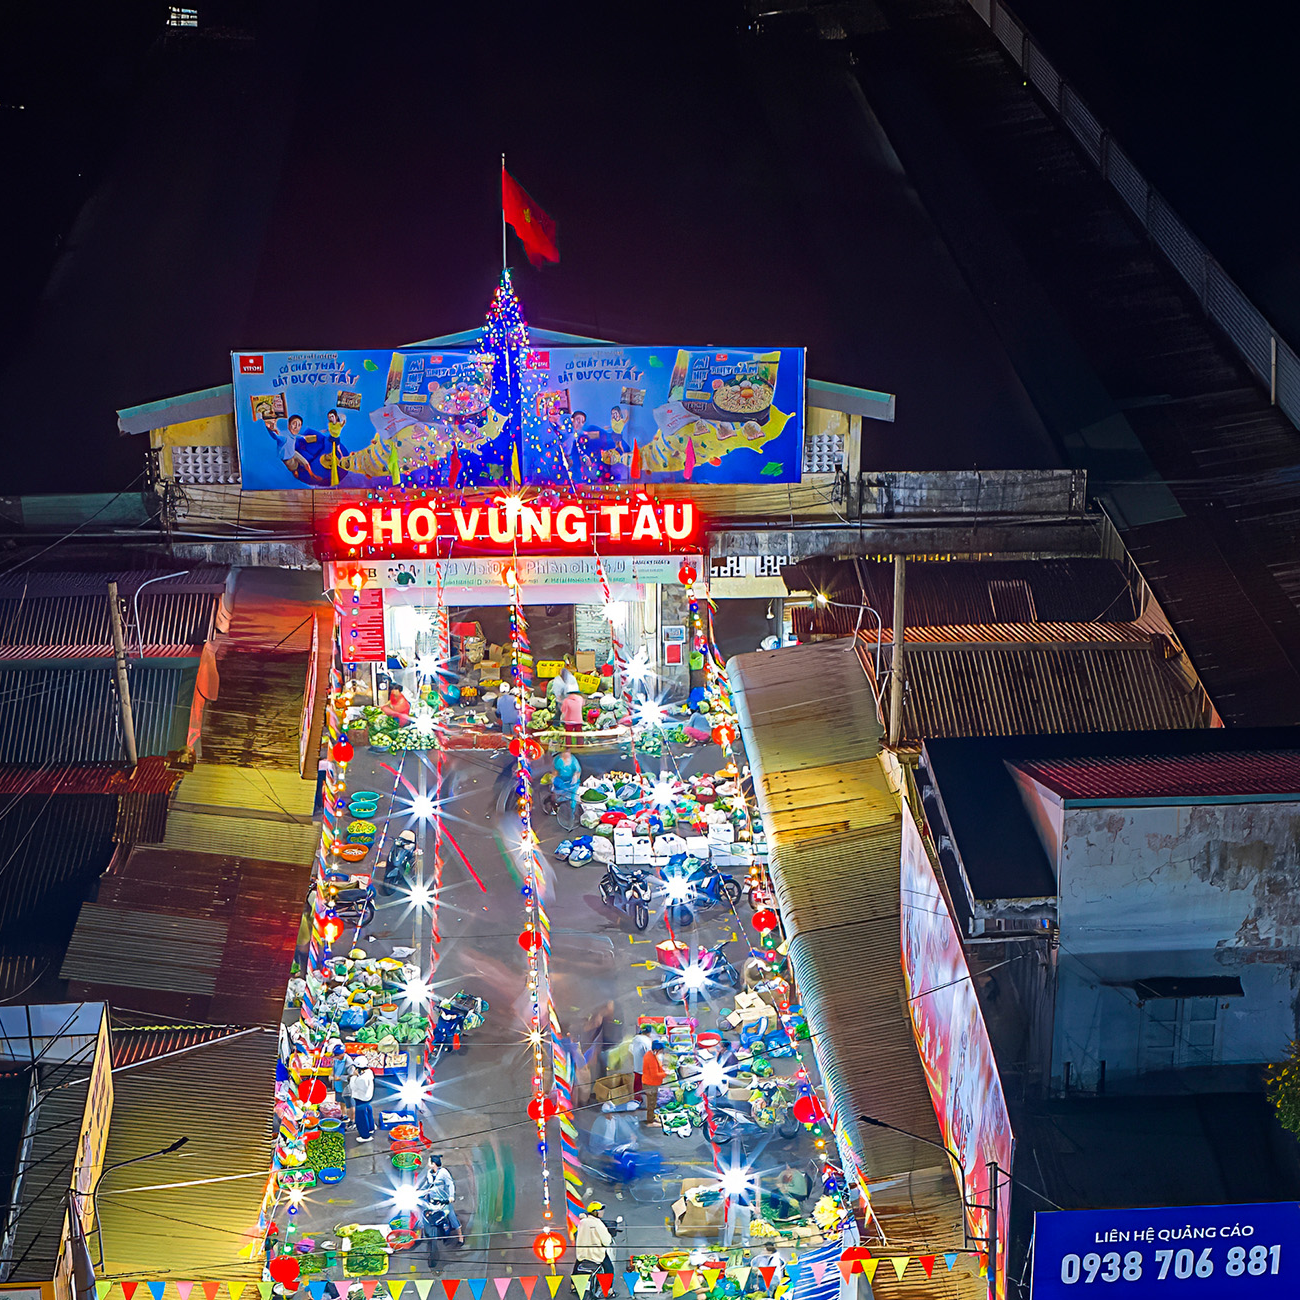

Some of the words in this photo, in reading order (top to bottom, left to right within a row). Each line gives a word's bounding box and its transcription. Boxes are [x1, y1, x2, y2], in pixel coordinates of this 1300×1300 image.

[337, 500, 438, 553] CHỢ
[451, 497, 588, 544] VŨNG
[600, 492, 694, 542] TÀU
[1095, 1227, 1131, 1244] LIÊN
[1133, 1225, 1155, 1245] HỆ
[1157, 1224, 1217, 1242] QUẢNG
[1219, 1223, 1254, 1239] CÁO
[1061, 1250, 1143, 1285] 0938
[1155, 1247, 1214, 1280] 706
[1225, 1244, 1282, 1277] 881
